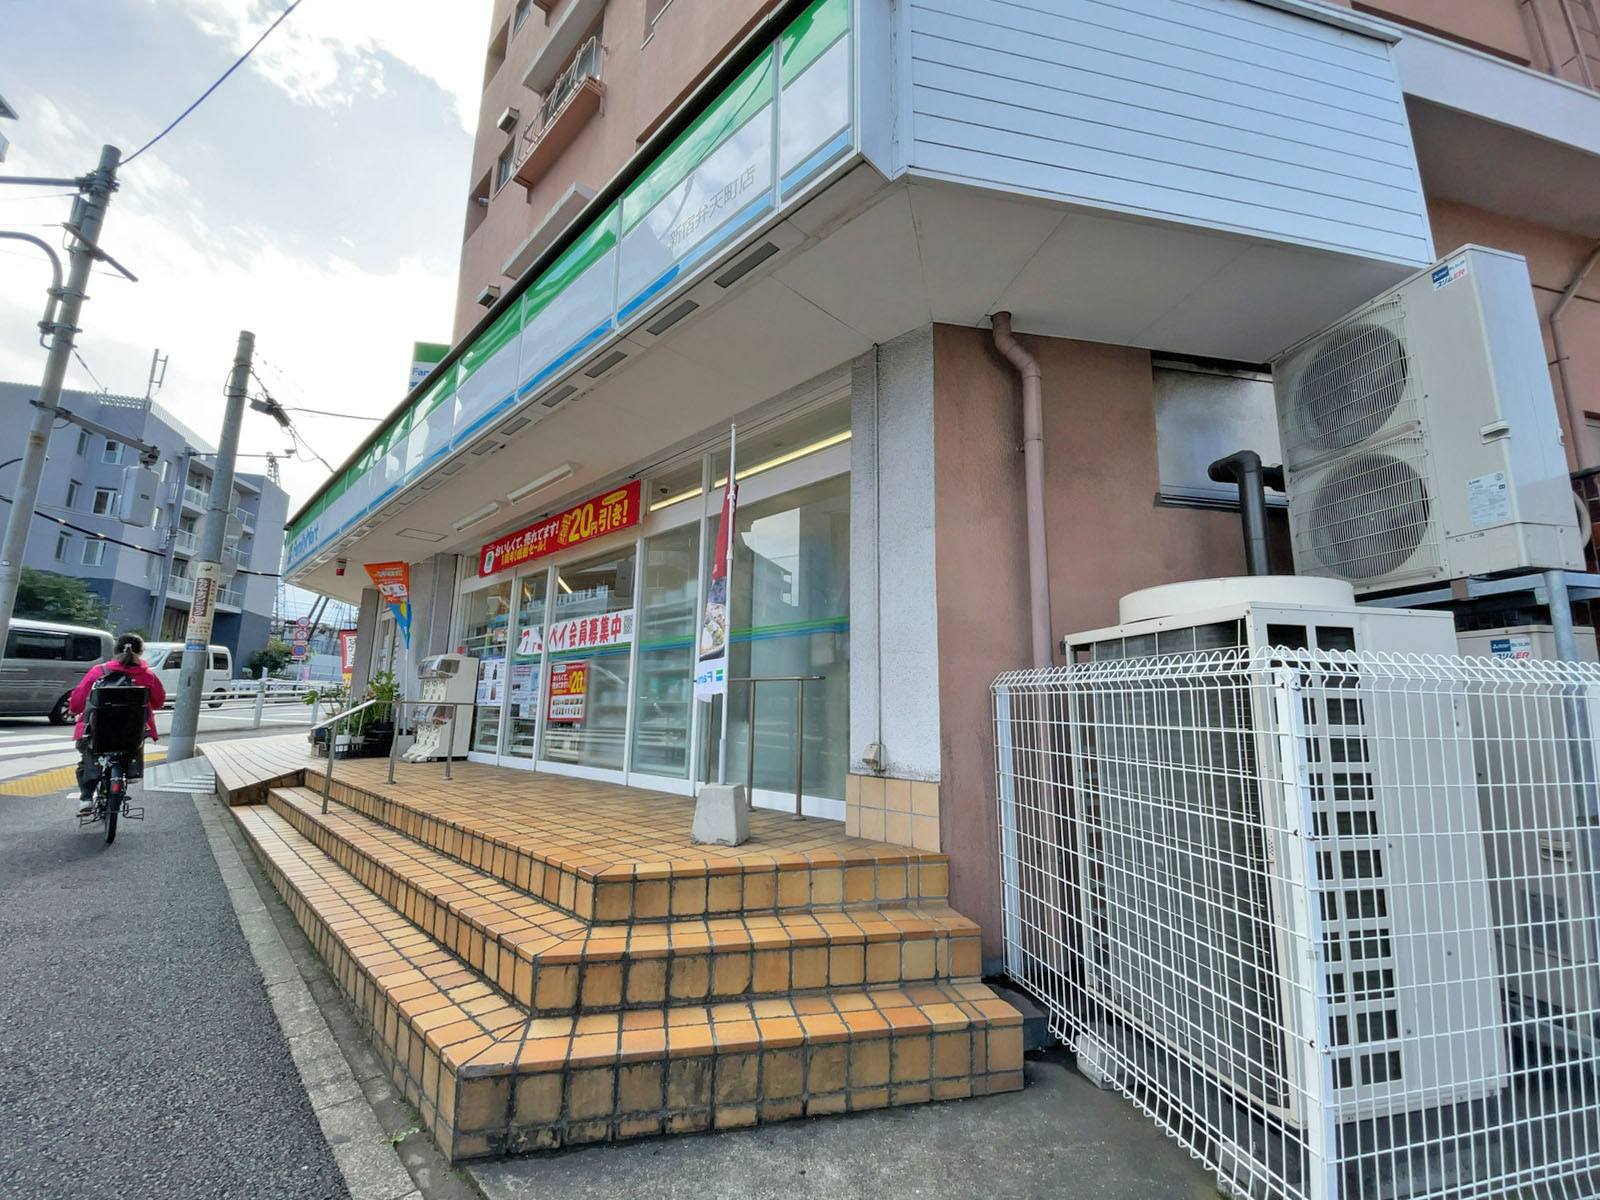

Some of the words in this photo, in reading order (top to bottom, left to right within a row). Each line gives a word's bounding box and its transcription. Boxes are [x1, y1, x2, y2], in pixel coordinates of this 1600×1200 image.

[670, 165, 756, 248] 新宿弁天町店
